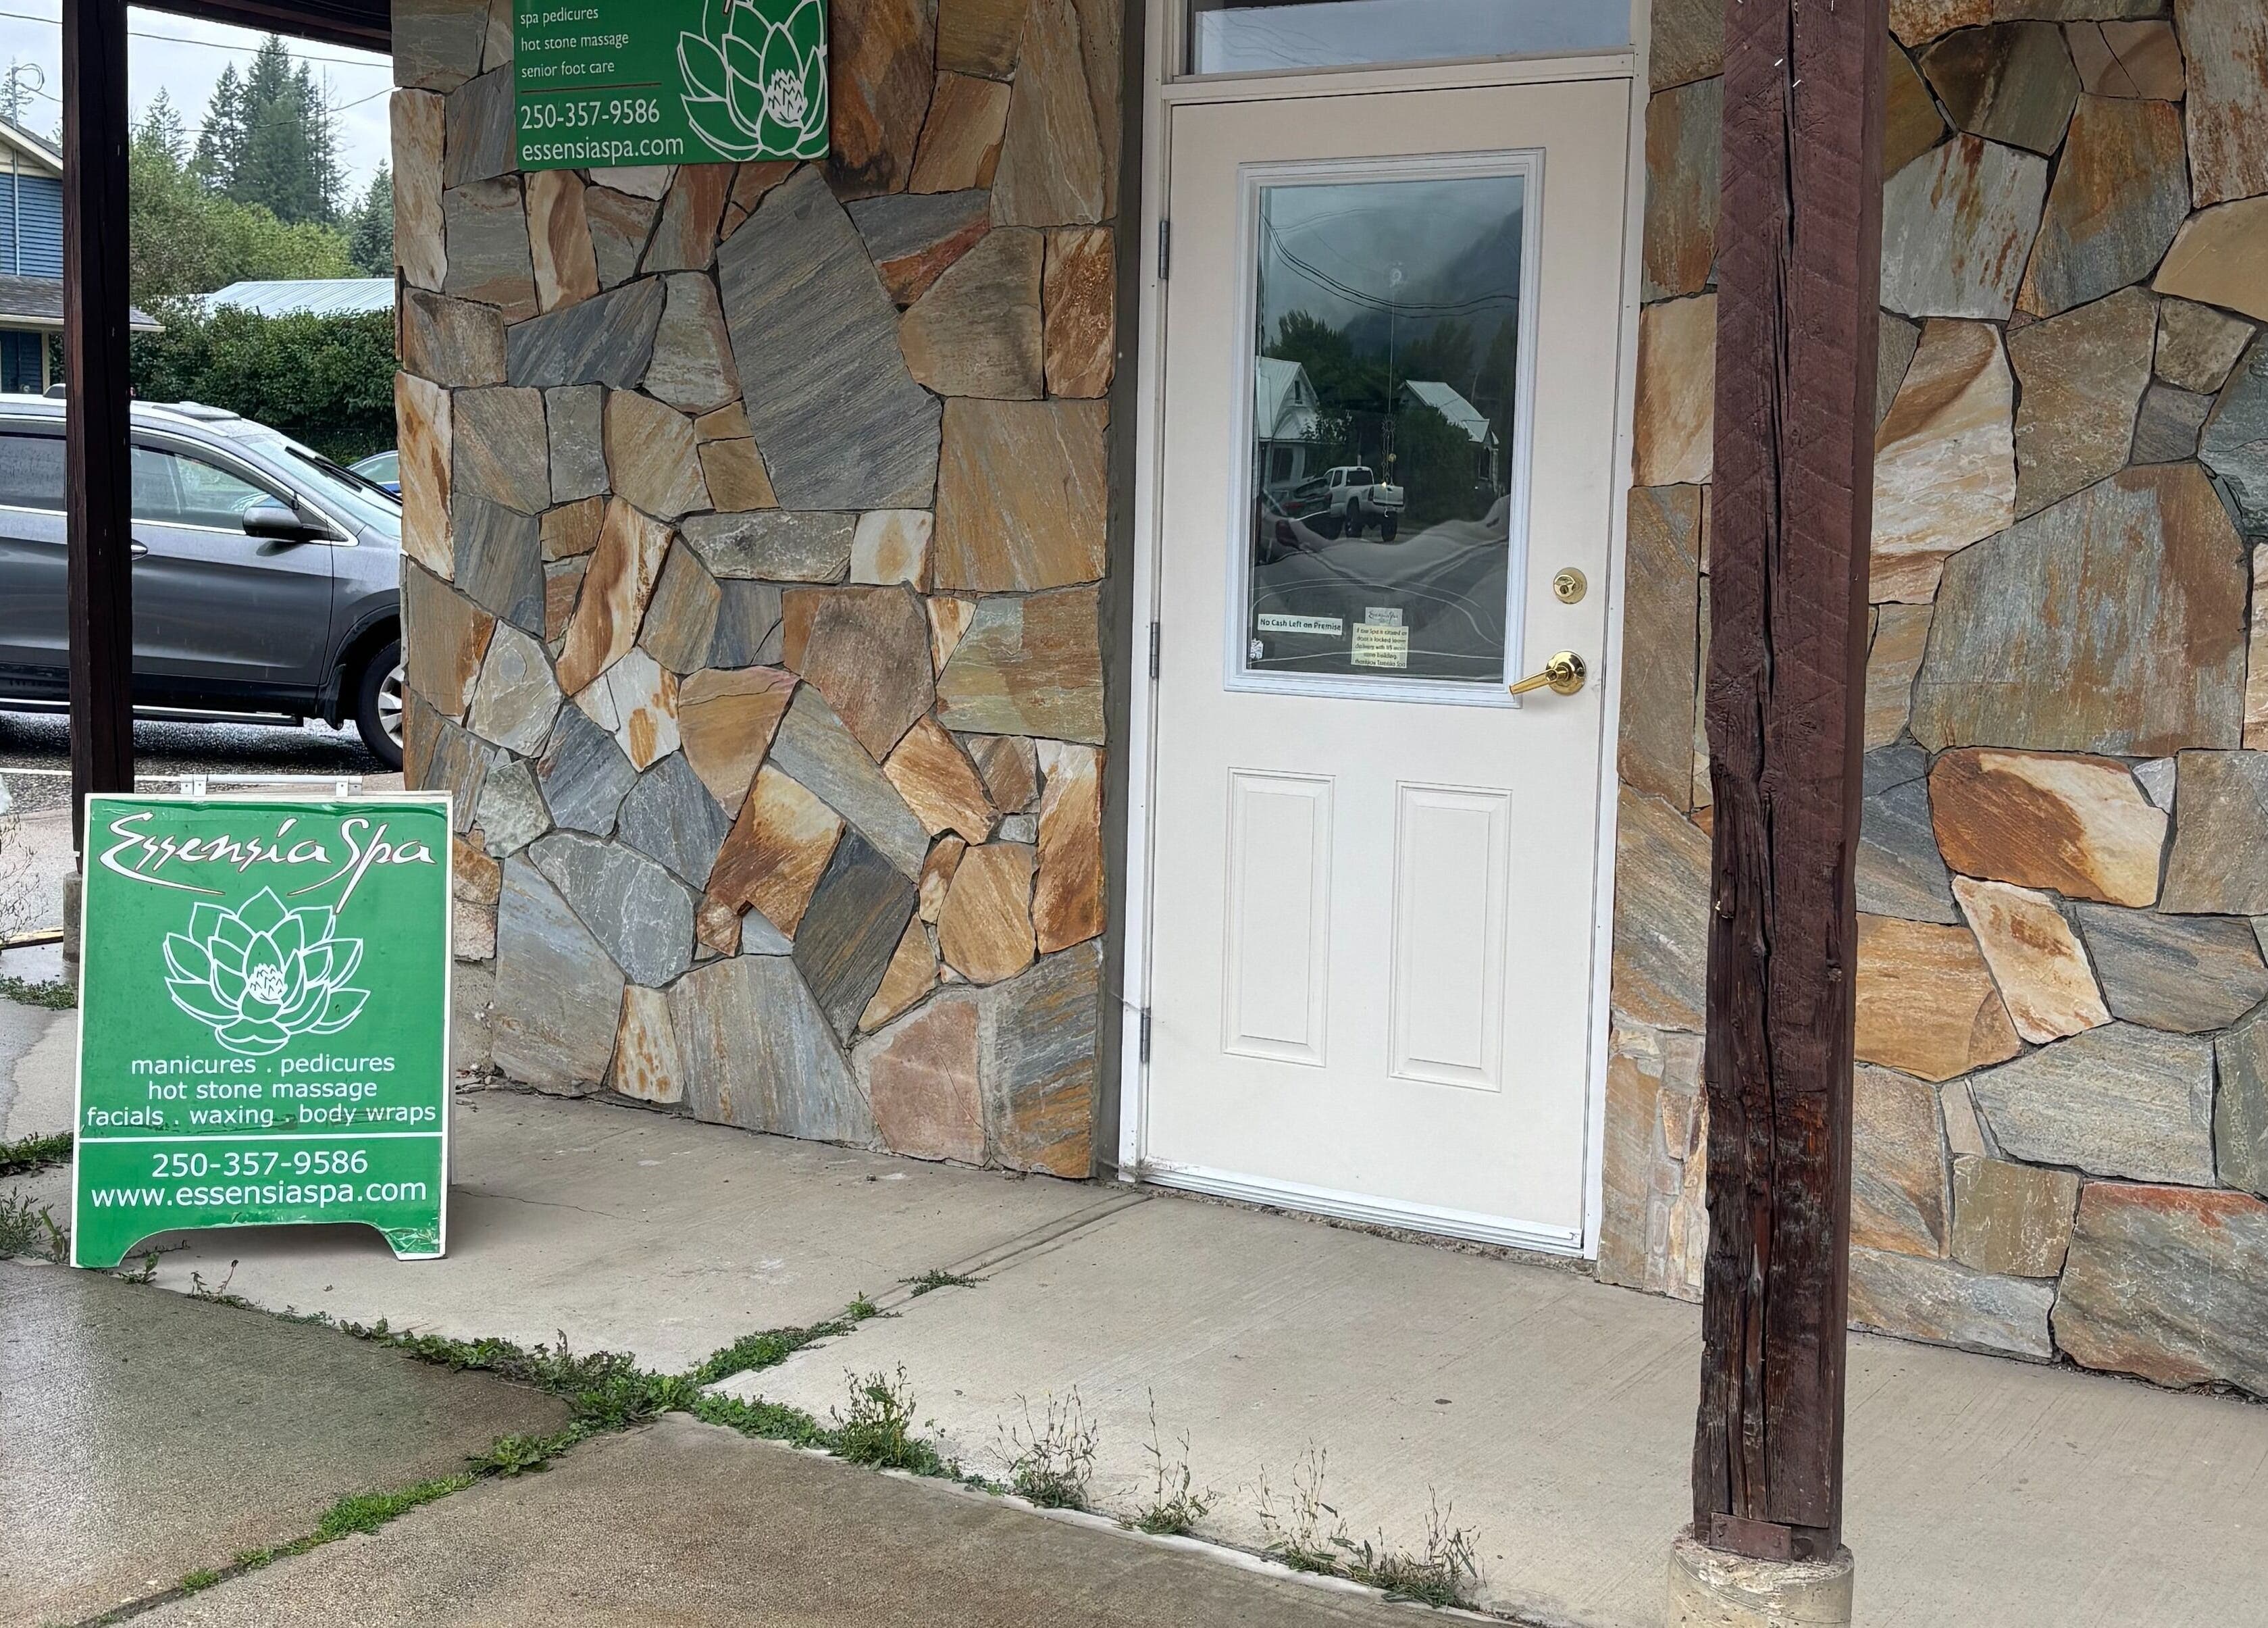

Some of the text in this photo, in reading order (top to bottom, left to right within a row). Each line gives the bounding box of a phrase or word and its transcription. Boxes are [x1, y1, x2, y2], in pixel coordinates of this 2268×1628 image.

[521, 7, 598, 28] spa pedicures
[521, 33, 629, 51] hot stone massage
[521, 61, 615, 78] senior foot care
[521, 98, 660, 130] 250-357-9586
[522, 136, 684, 166] essensiaspa.com
[287, 817, 437, 914] Spa
[132, 1056, 256, 1074] manicures
[280, 1054, 396, 1076] pedicures
[149, 1081, 378, 1102] hot stone massage
[86, 1106, 163, 1126] facials
[190, 1105, 274, 1127] waxing
[299, 1104, 358, 1127] body
[366, 1104, 436, 1125] wraps
[152, 1150, 368, 1177] 250-357-9586
[91, 1181, 426, 1209] www.essensiaspa.com
